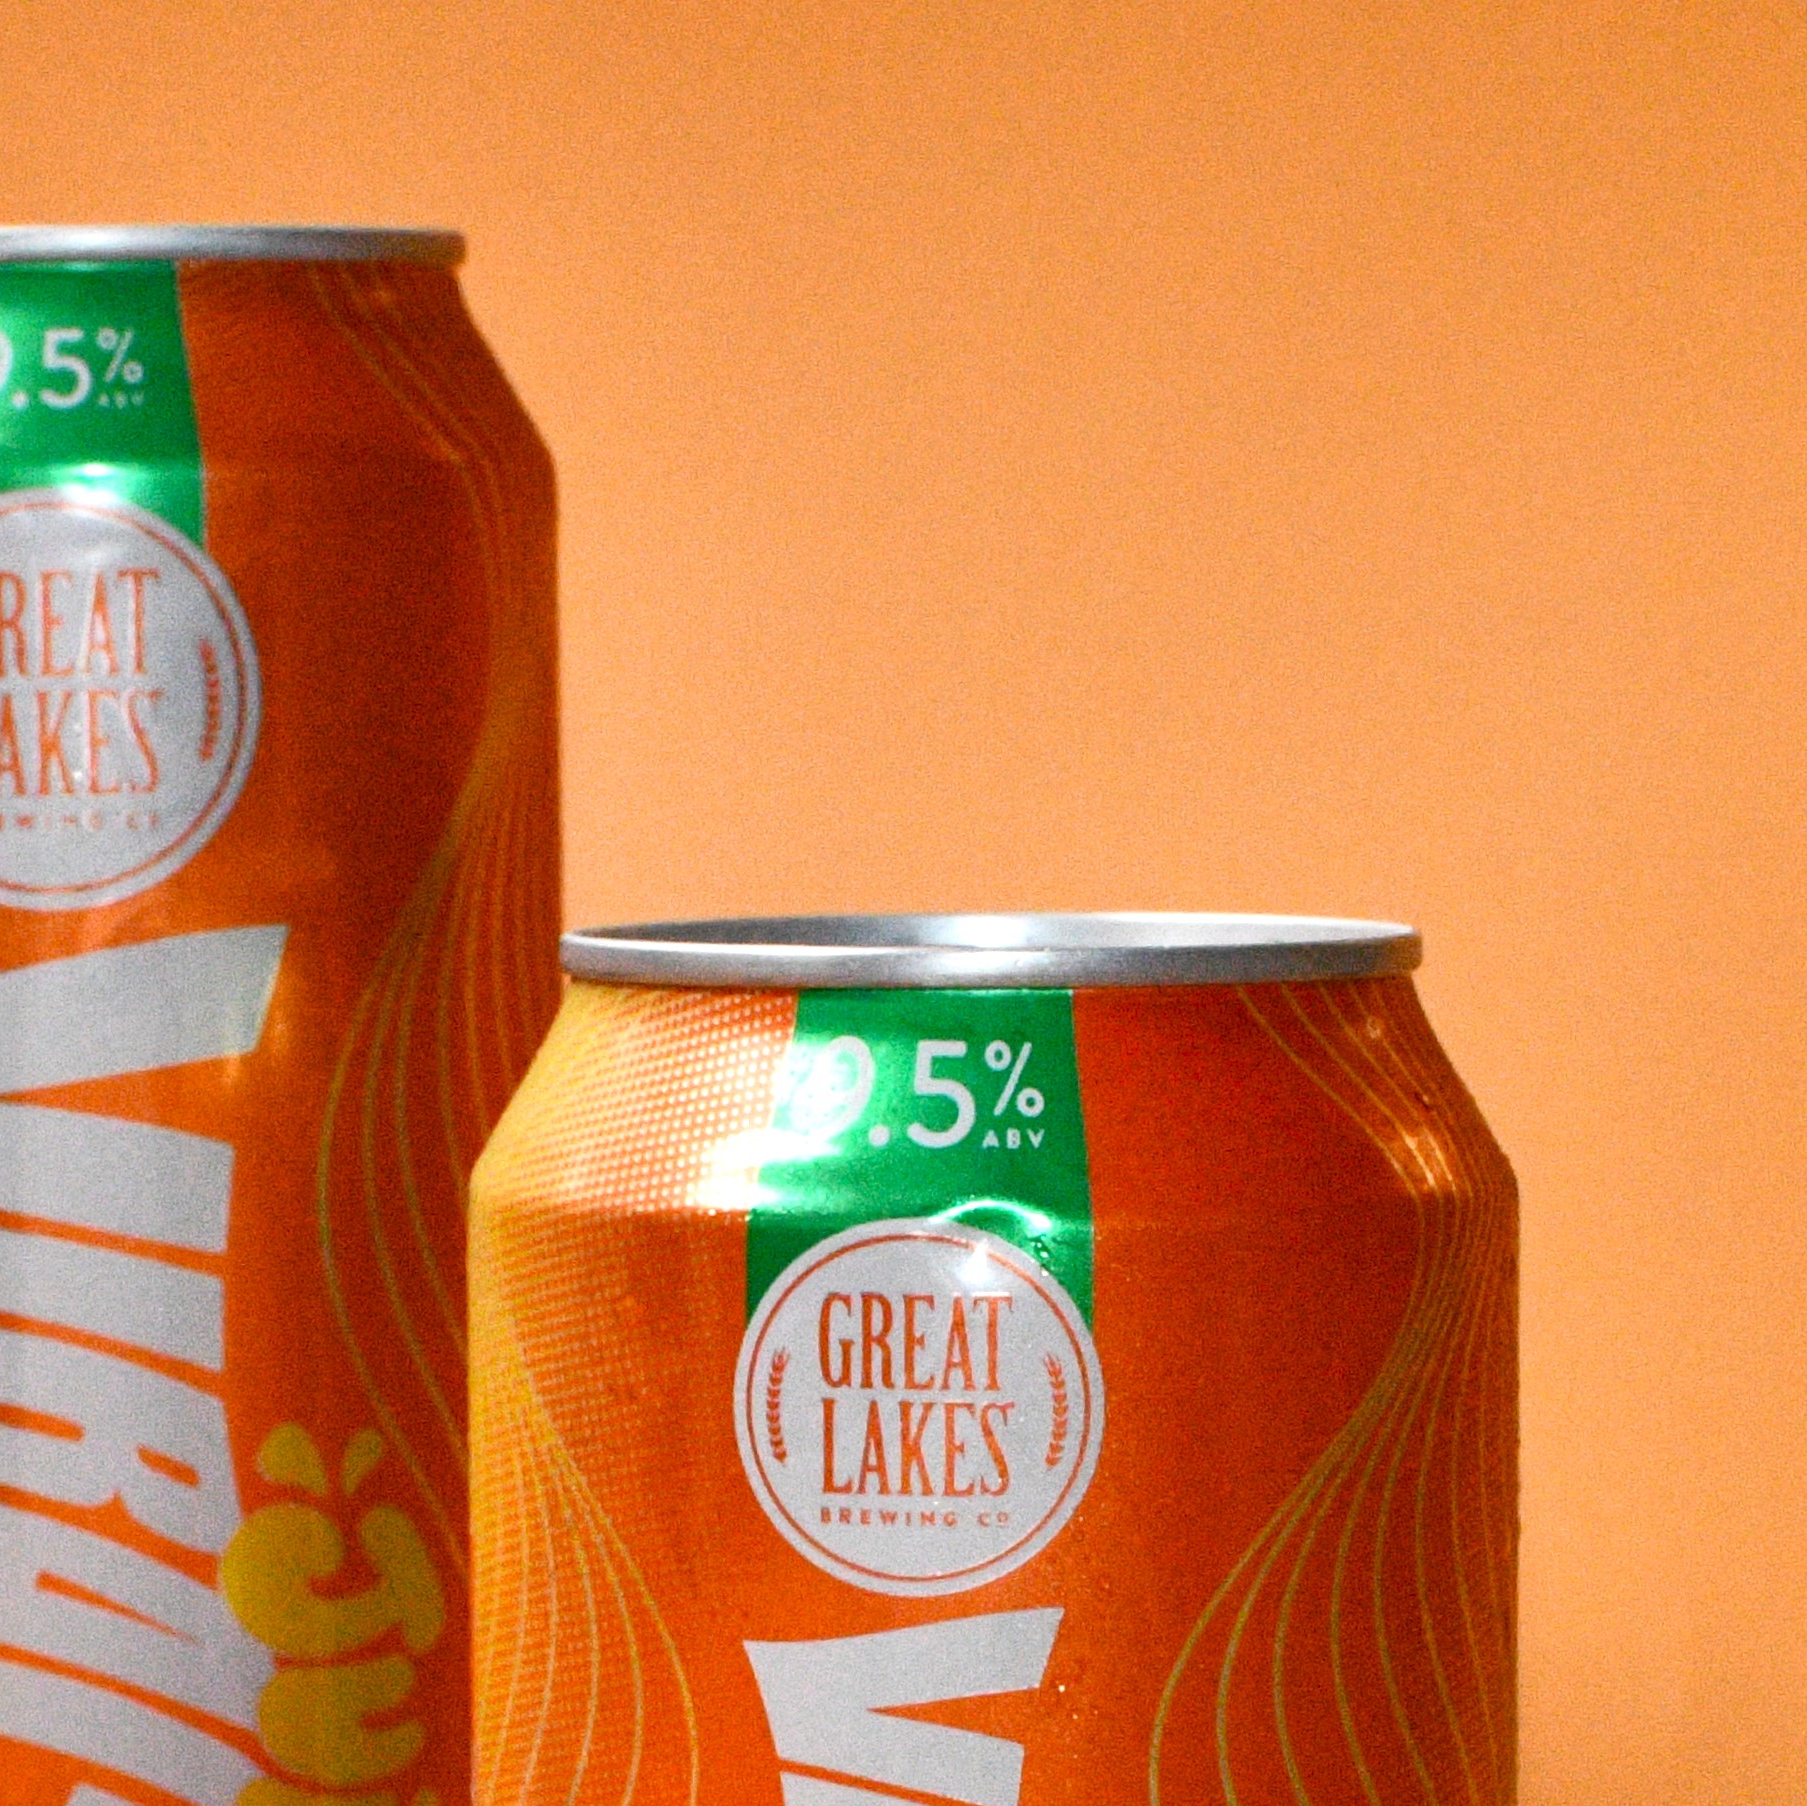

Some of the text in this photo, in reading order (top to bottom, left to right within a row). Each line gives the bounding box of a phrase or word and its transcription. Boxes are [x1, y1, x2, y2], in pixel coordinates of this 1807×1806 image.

[795, 1035, 1044, 1150] 9.5%
[982, 1128, 1045, 1149] ABV
[819, 1291, 1013, 1391] GREAT
[821, 1397, 1015, 1496] LAKES
[820, 1507, 959, 1528] BREWING
